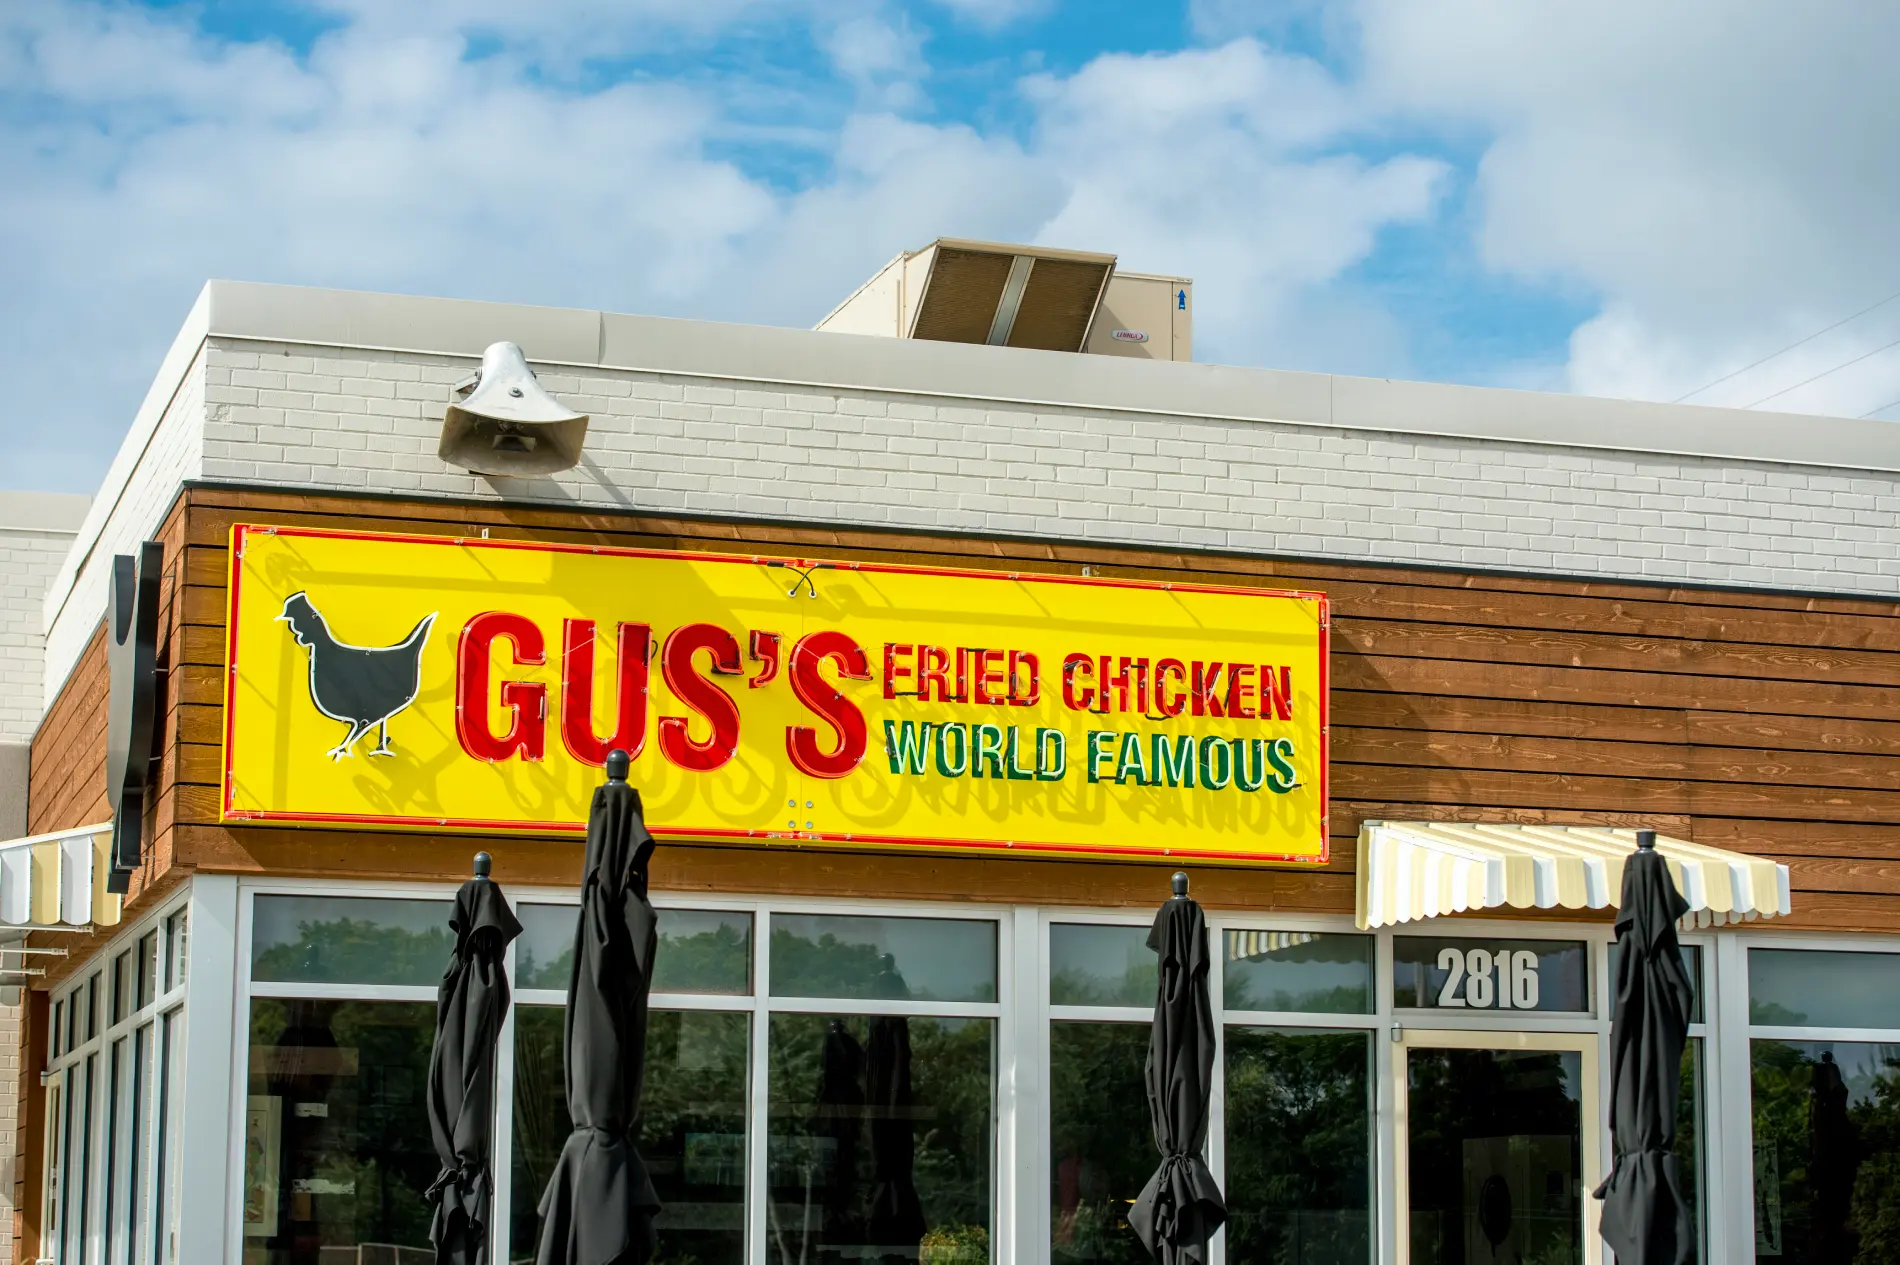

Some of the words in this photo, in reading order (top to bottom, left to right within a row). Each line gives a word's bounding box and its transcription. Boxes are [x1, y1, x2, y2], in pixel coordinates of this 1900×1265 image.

[456, 610, 873, 779] GUS'S
[883, 642, 1041, 706] FRIED
[1062, 652, 1294, 720] CHICKEN
[883, 720, 1067, 782] WORLD
[1087, 731, 1297, 794] FAMOUS
[1437, 947, 1539, 1009] 2816
